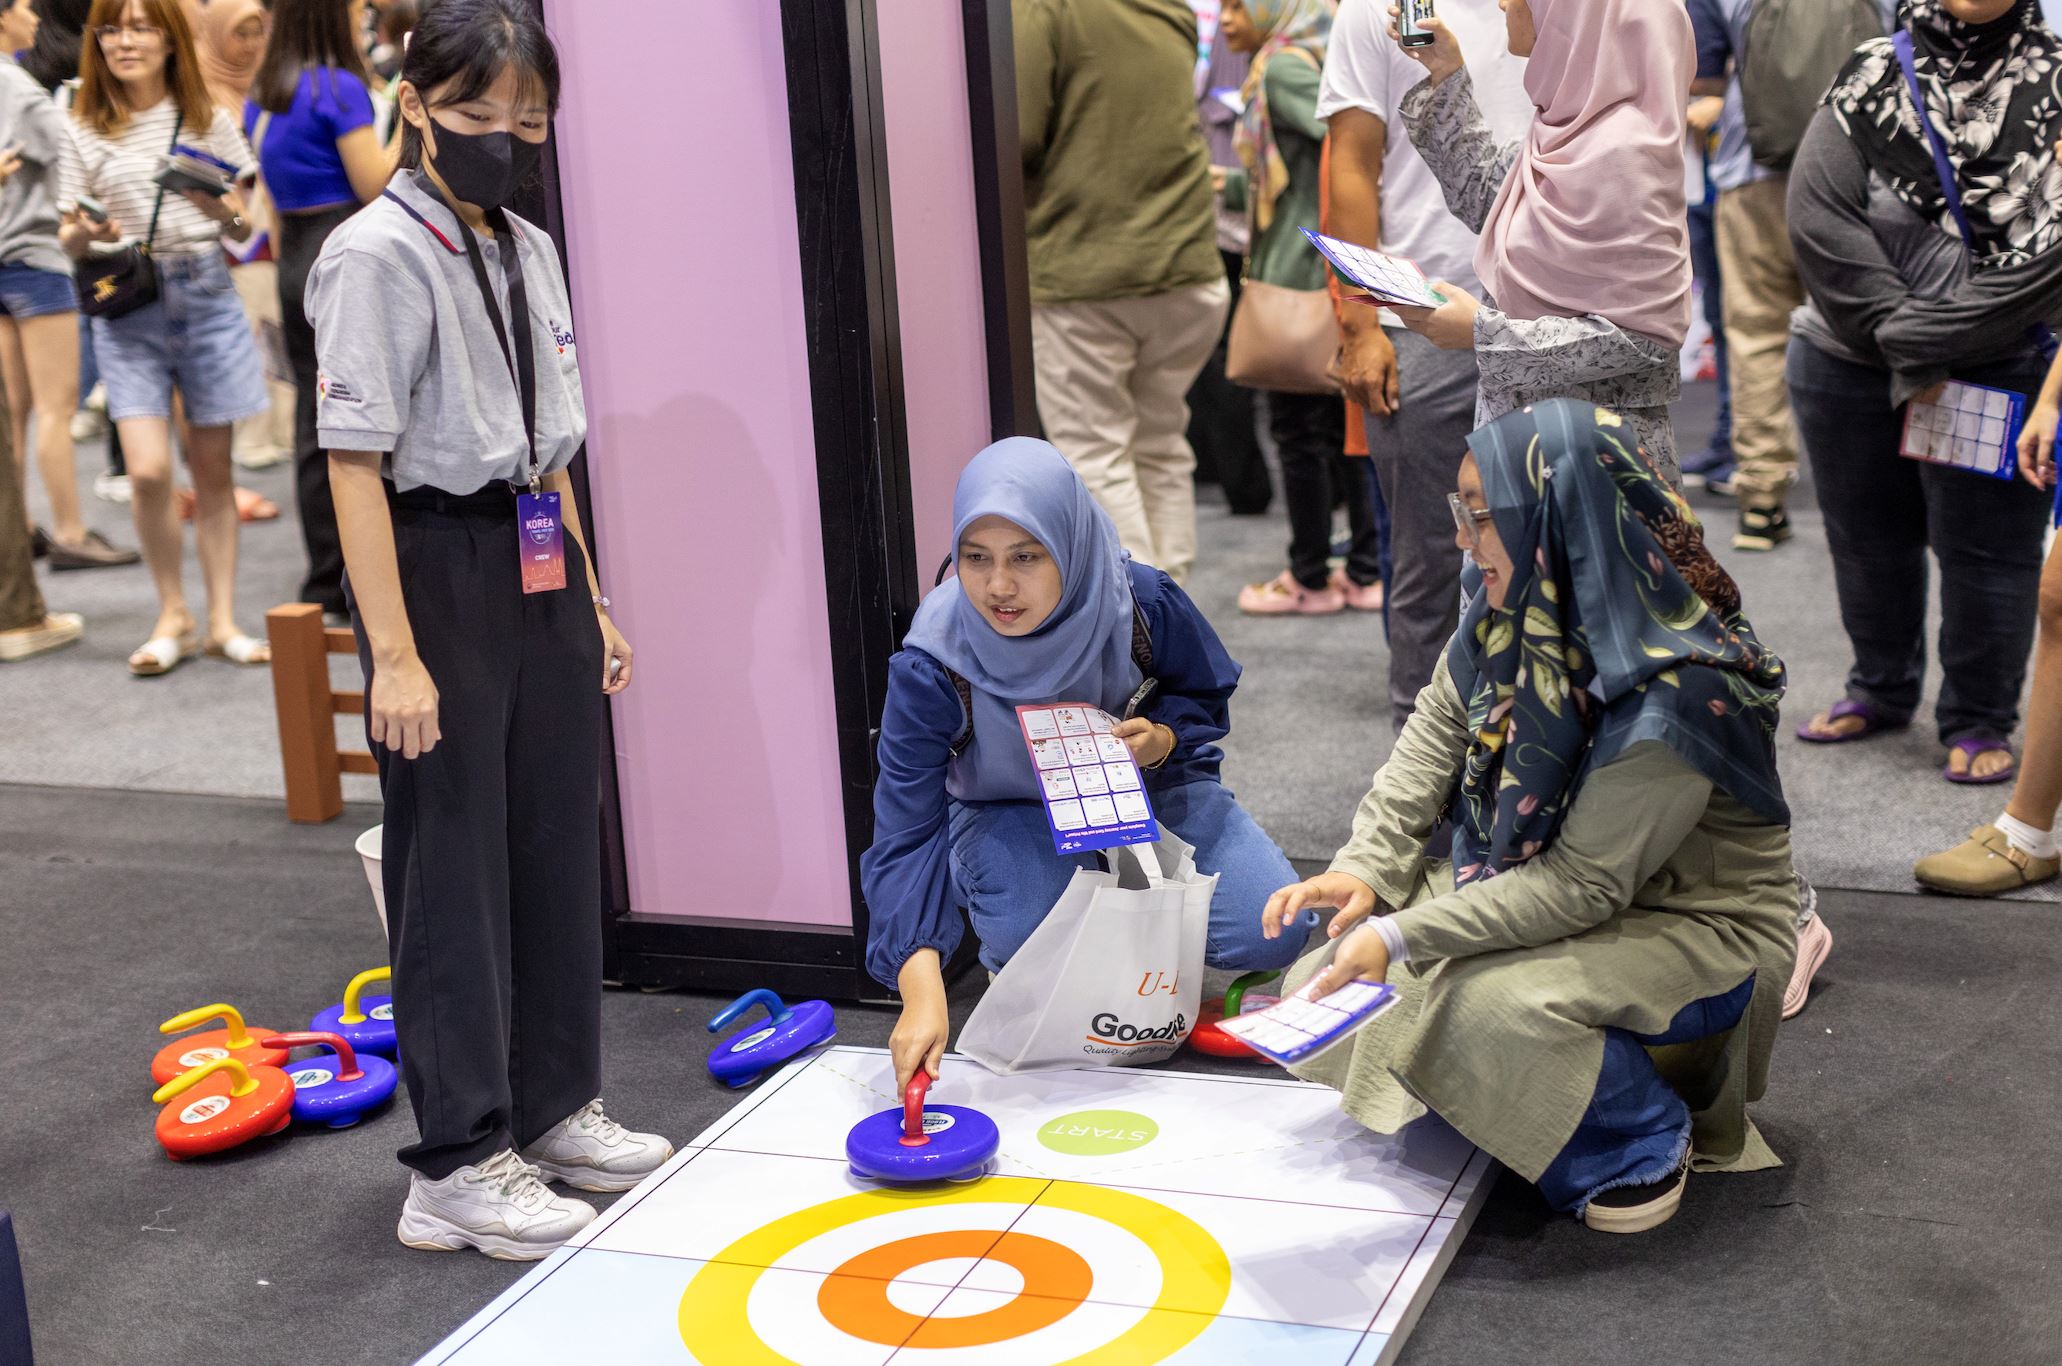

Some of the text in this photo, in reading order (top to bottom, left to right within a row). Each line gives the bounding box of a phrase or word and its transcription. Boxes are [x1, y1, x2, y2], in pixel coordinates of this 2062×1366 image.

[525, 517, 554, 530] KOREA
[534, 553, 550, 561] CREW
[1047, 1124, 1149, 1142] START
